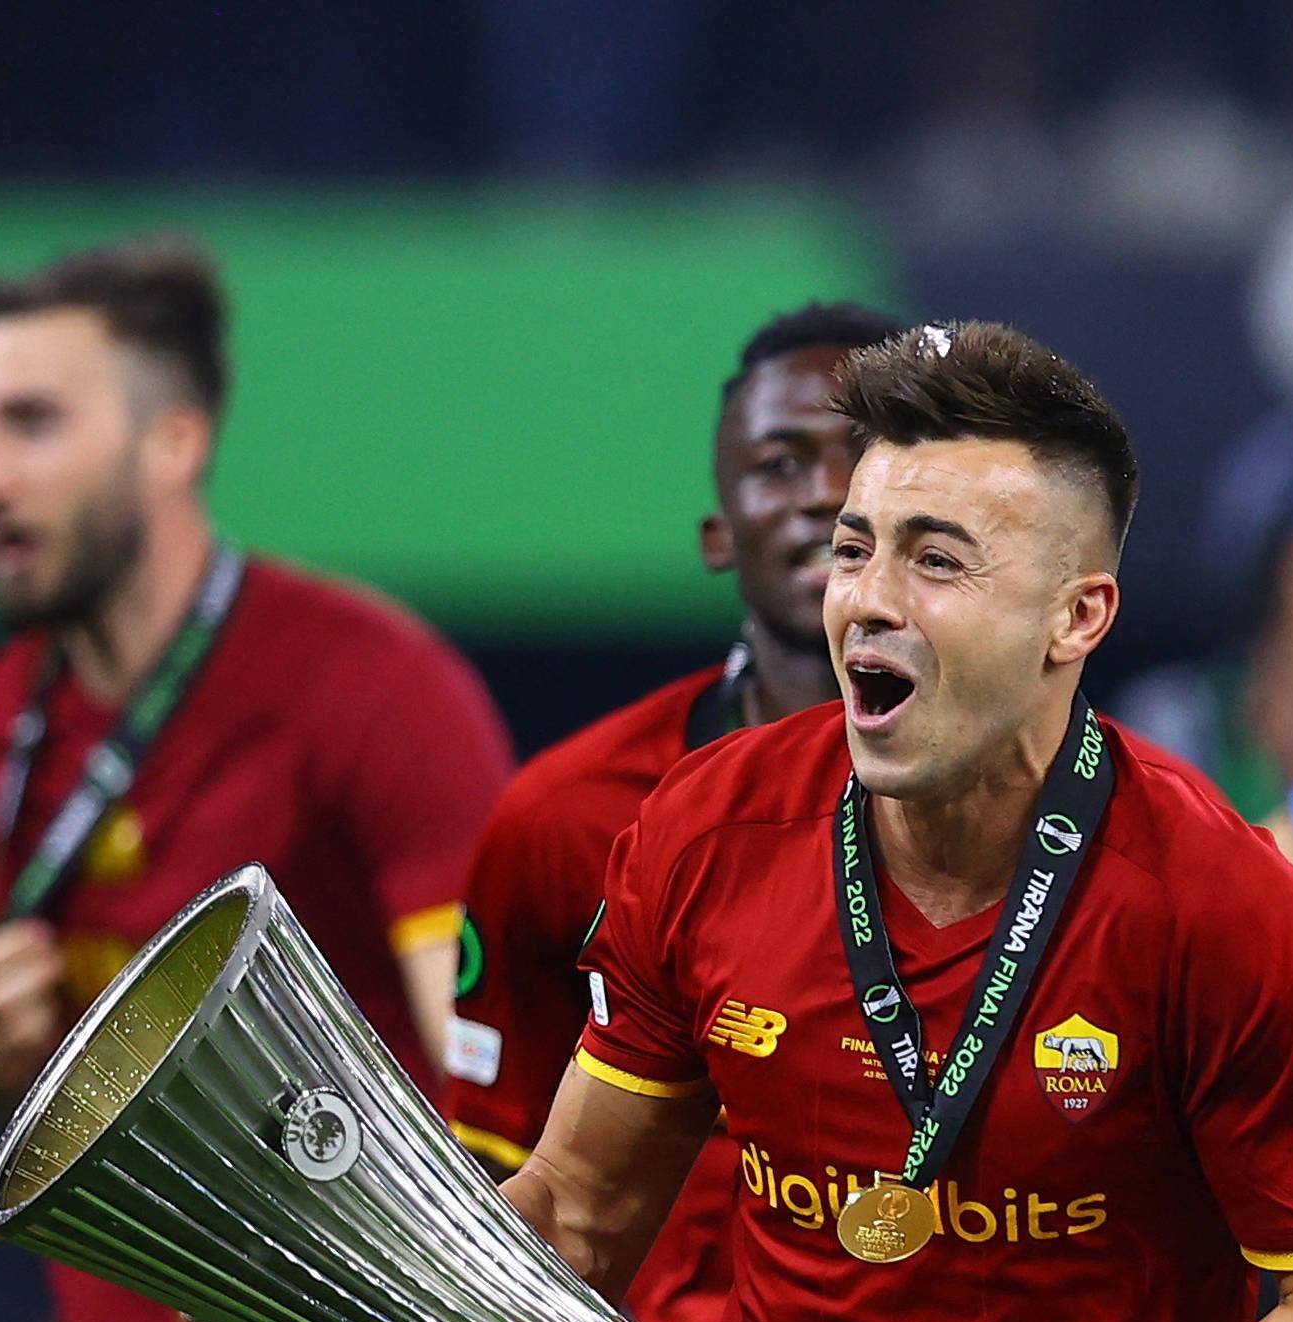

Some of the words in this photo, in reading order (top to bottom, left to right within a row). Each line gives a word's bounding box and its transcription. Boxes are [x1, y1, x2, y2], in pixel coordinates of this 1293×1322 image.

[1073, 723, 1104, 780] 2022
[842, 799, 860, 878] FINAL
[846, 880, 873, 947] 2022
[972, 955, 1018, 1028] FINAL
[842, 1037, 876, 1054] FINA
[938, 1033, 984, 1097] 2022
[1045, 1076, 1107, 1093] ROMA
[1063, 1098, 1088, 1109] 1927
[287, 1096, 324, 1143] UEFA
